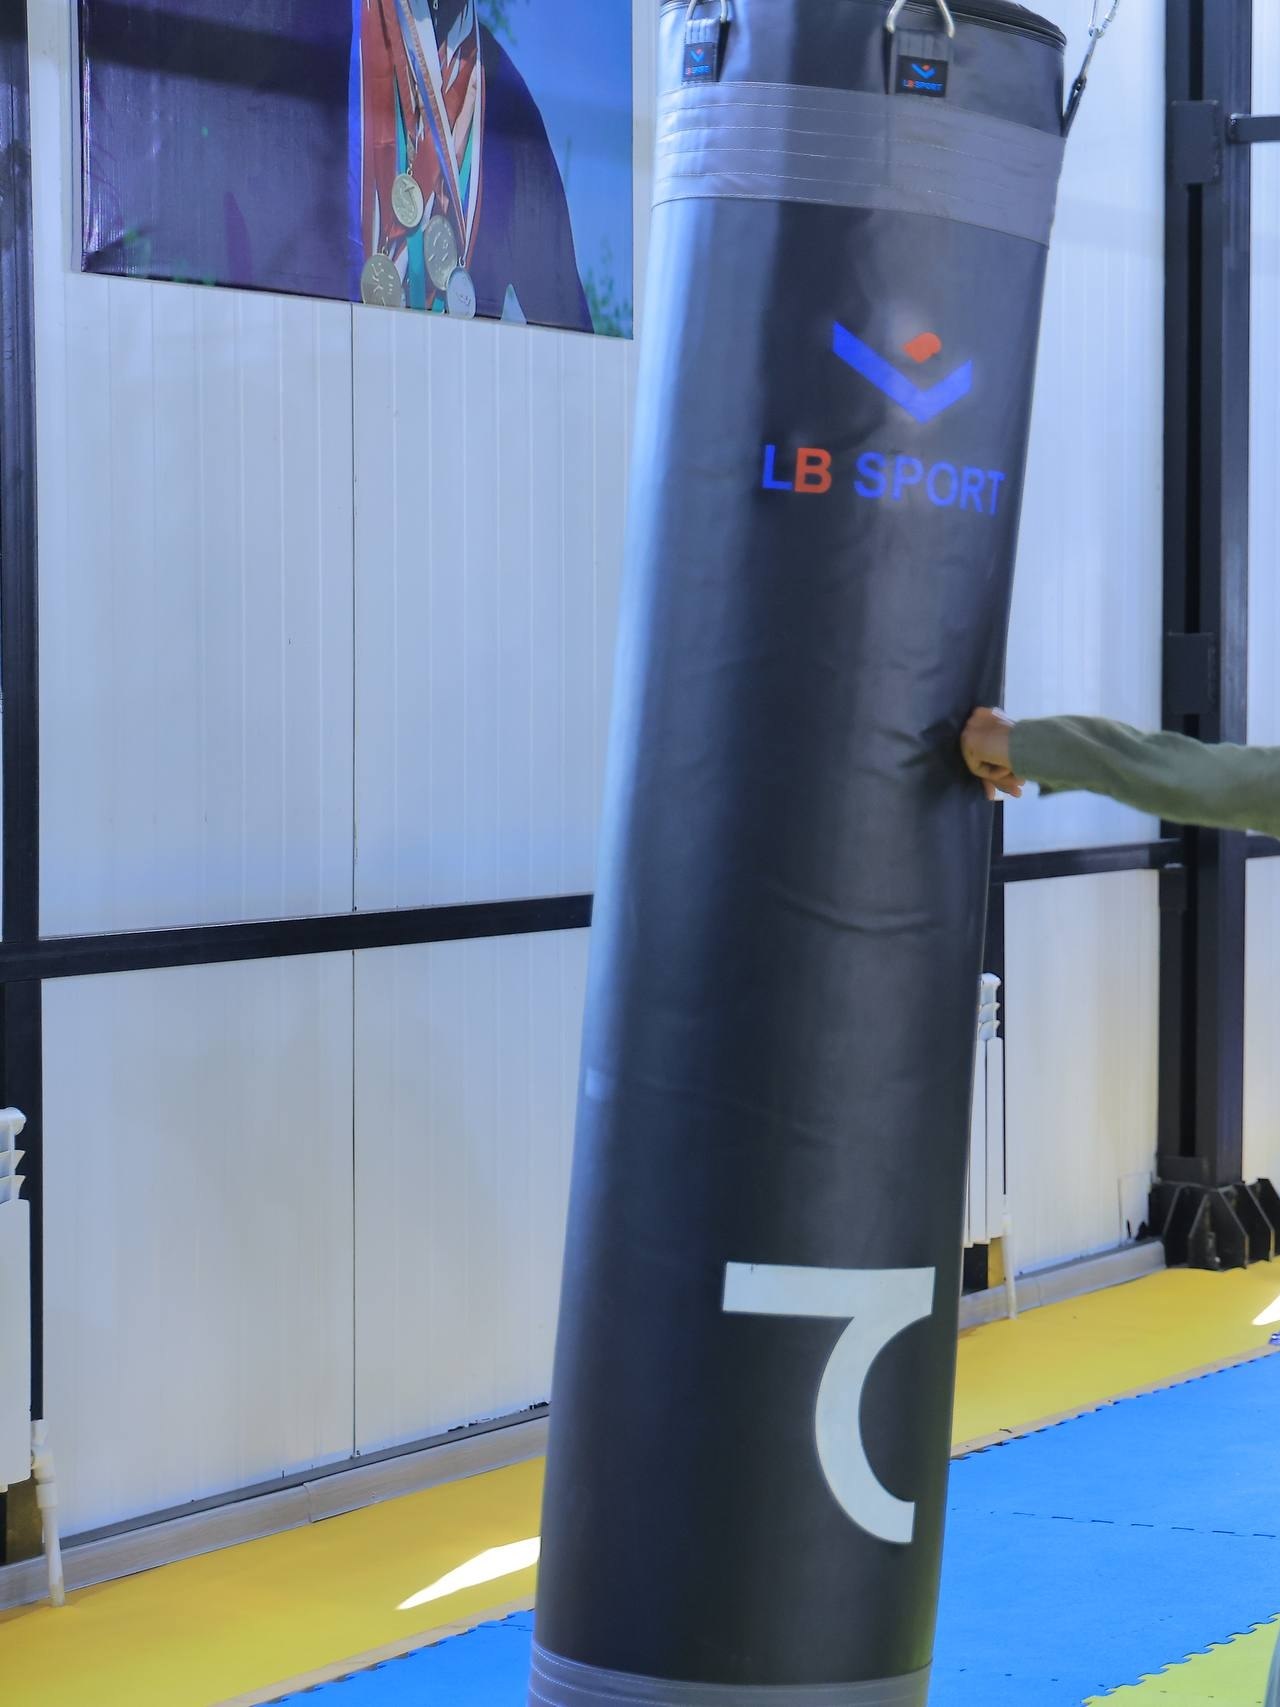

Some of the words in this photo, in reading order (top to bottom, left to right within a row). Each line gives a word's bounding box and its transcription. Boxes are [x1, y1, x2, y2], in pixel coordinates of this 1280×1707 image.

[903, 79, 914, 89] LB
[915, 80, 944, 92] SPORT
[762, 444, 832, 493] LB
[853, 451, 1005, 516] SPORT
